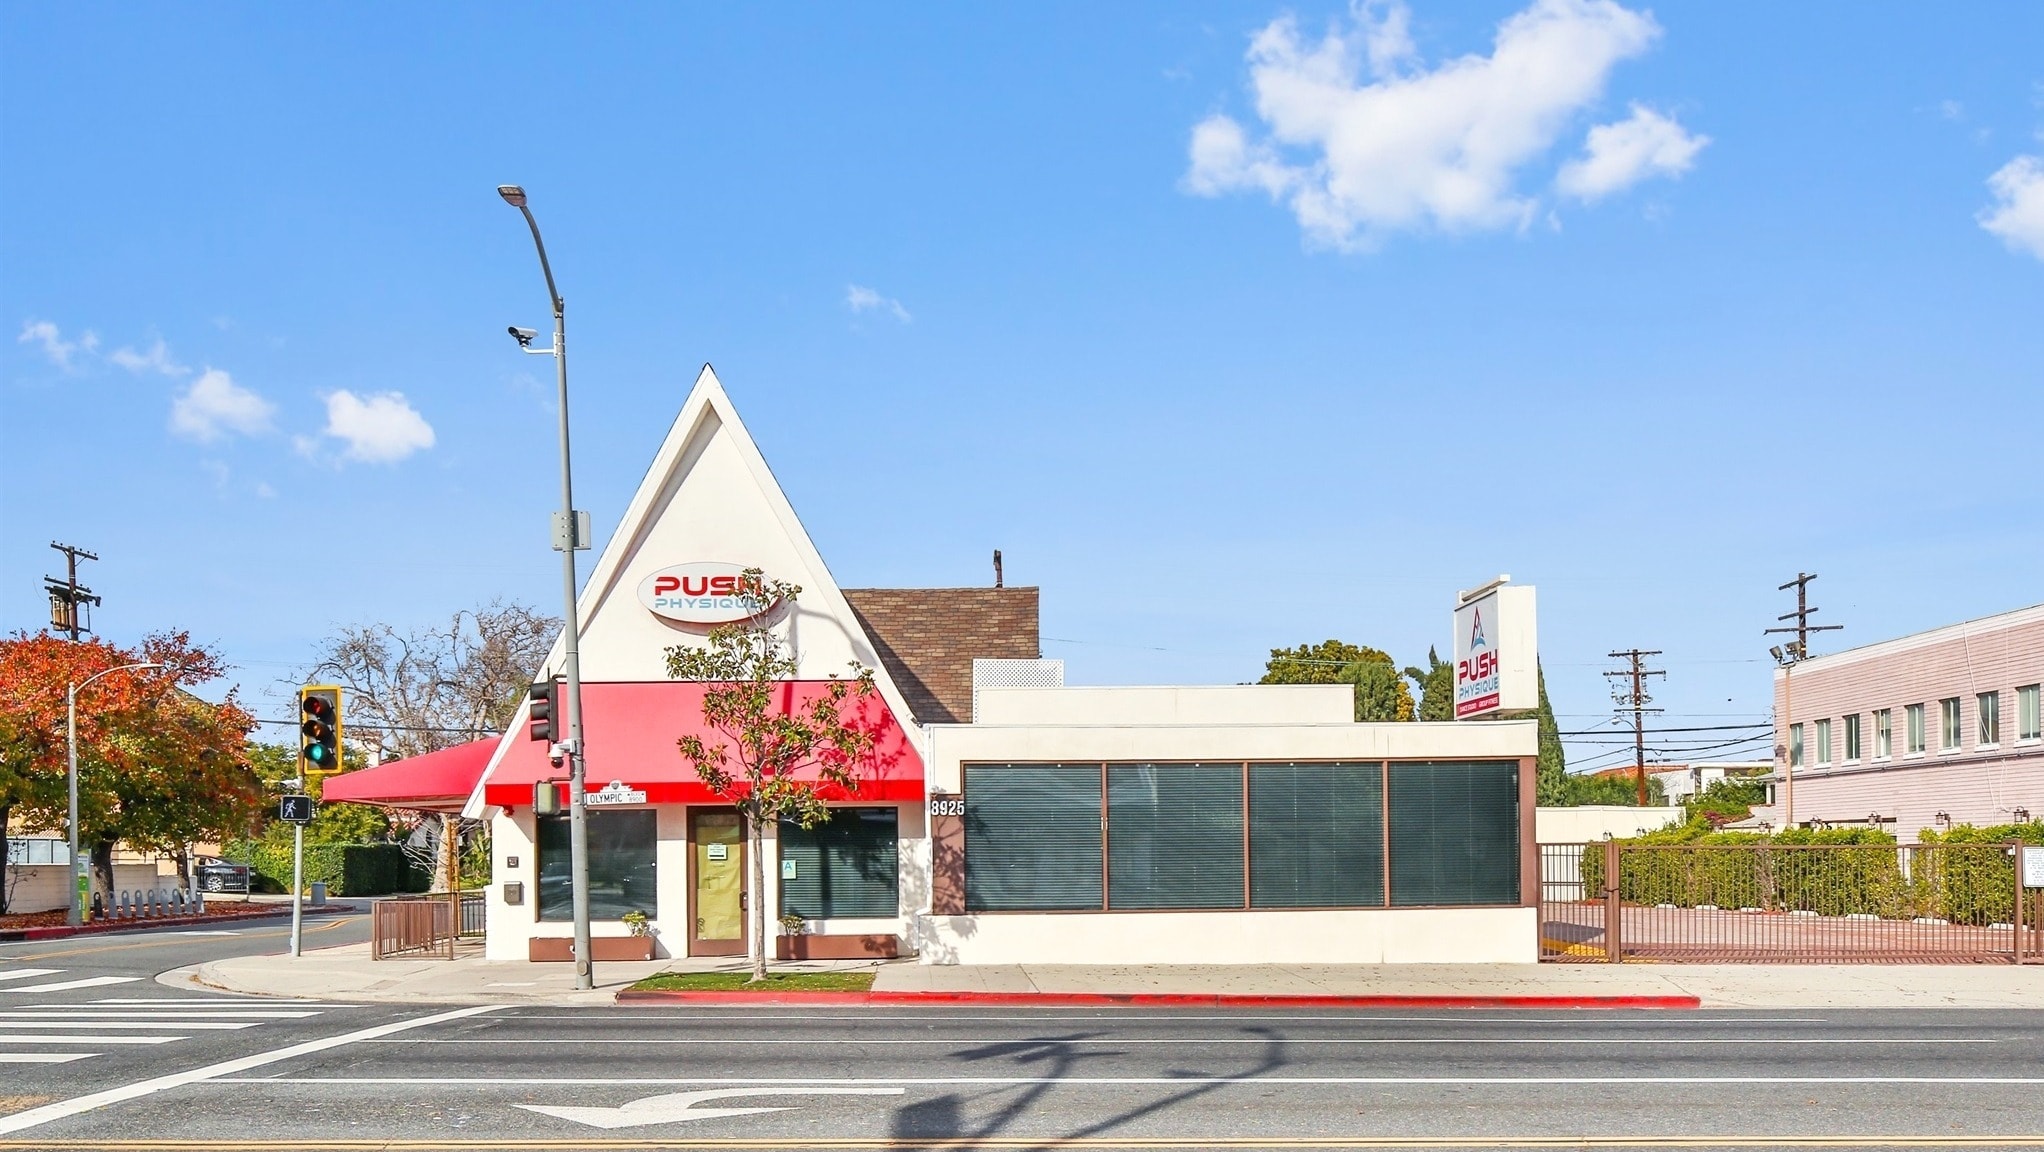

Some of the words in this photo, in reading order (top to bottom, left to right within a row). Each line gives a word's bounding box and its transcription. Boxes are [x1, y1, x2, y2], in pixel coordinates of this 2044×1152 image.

[654, 576, 762, 597] PUSH
[1459, 648, 1498, 685] PUSH
[1459, 677, 1499, 699] PHYSIQUE
[590, 793, 622, 803] OLYMPIC
[931, 800, 965, 816] 8925
[784, 862, 792, 870] A
